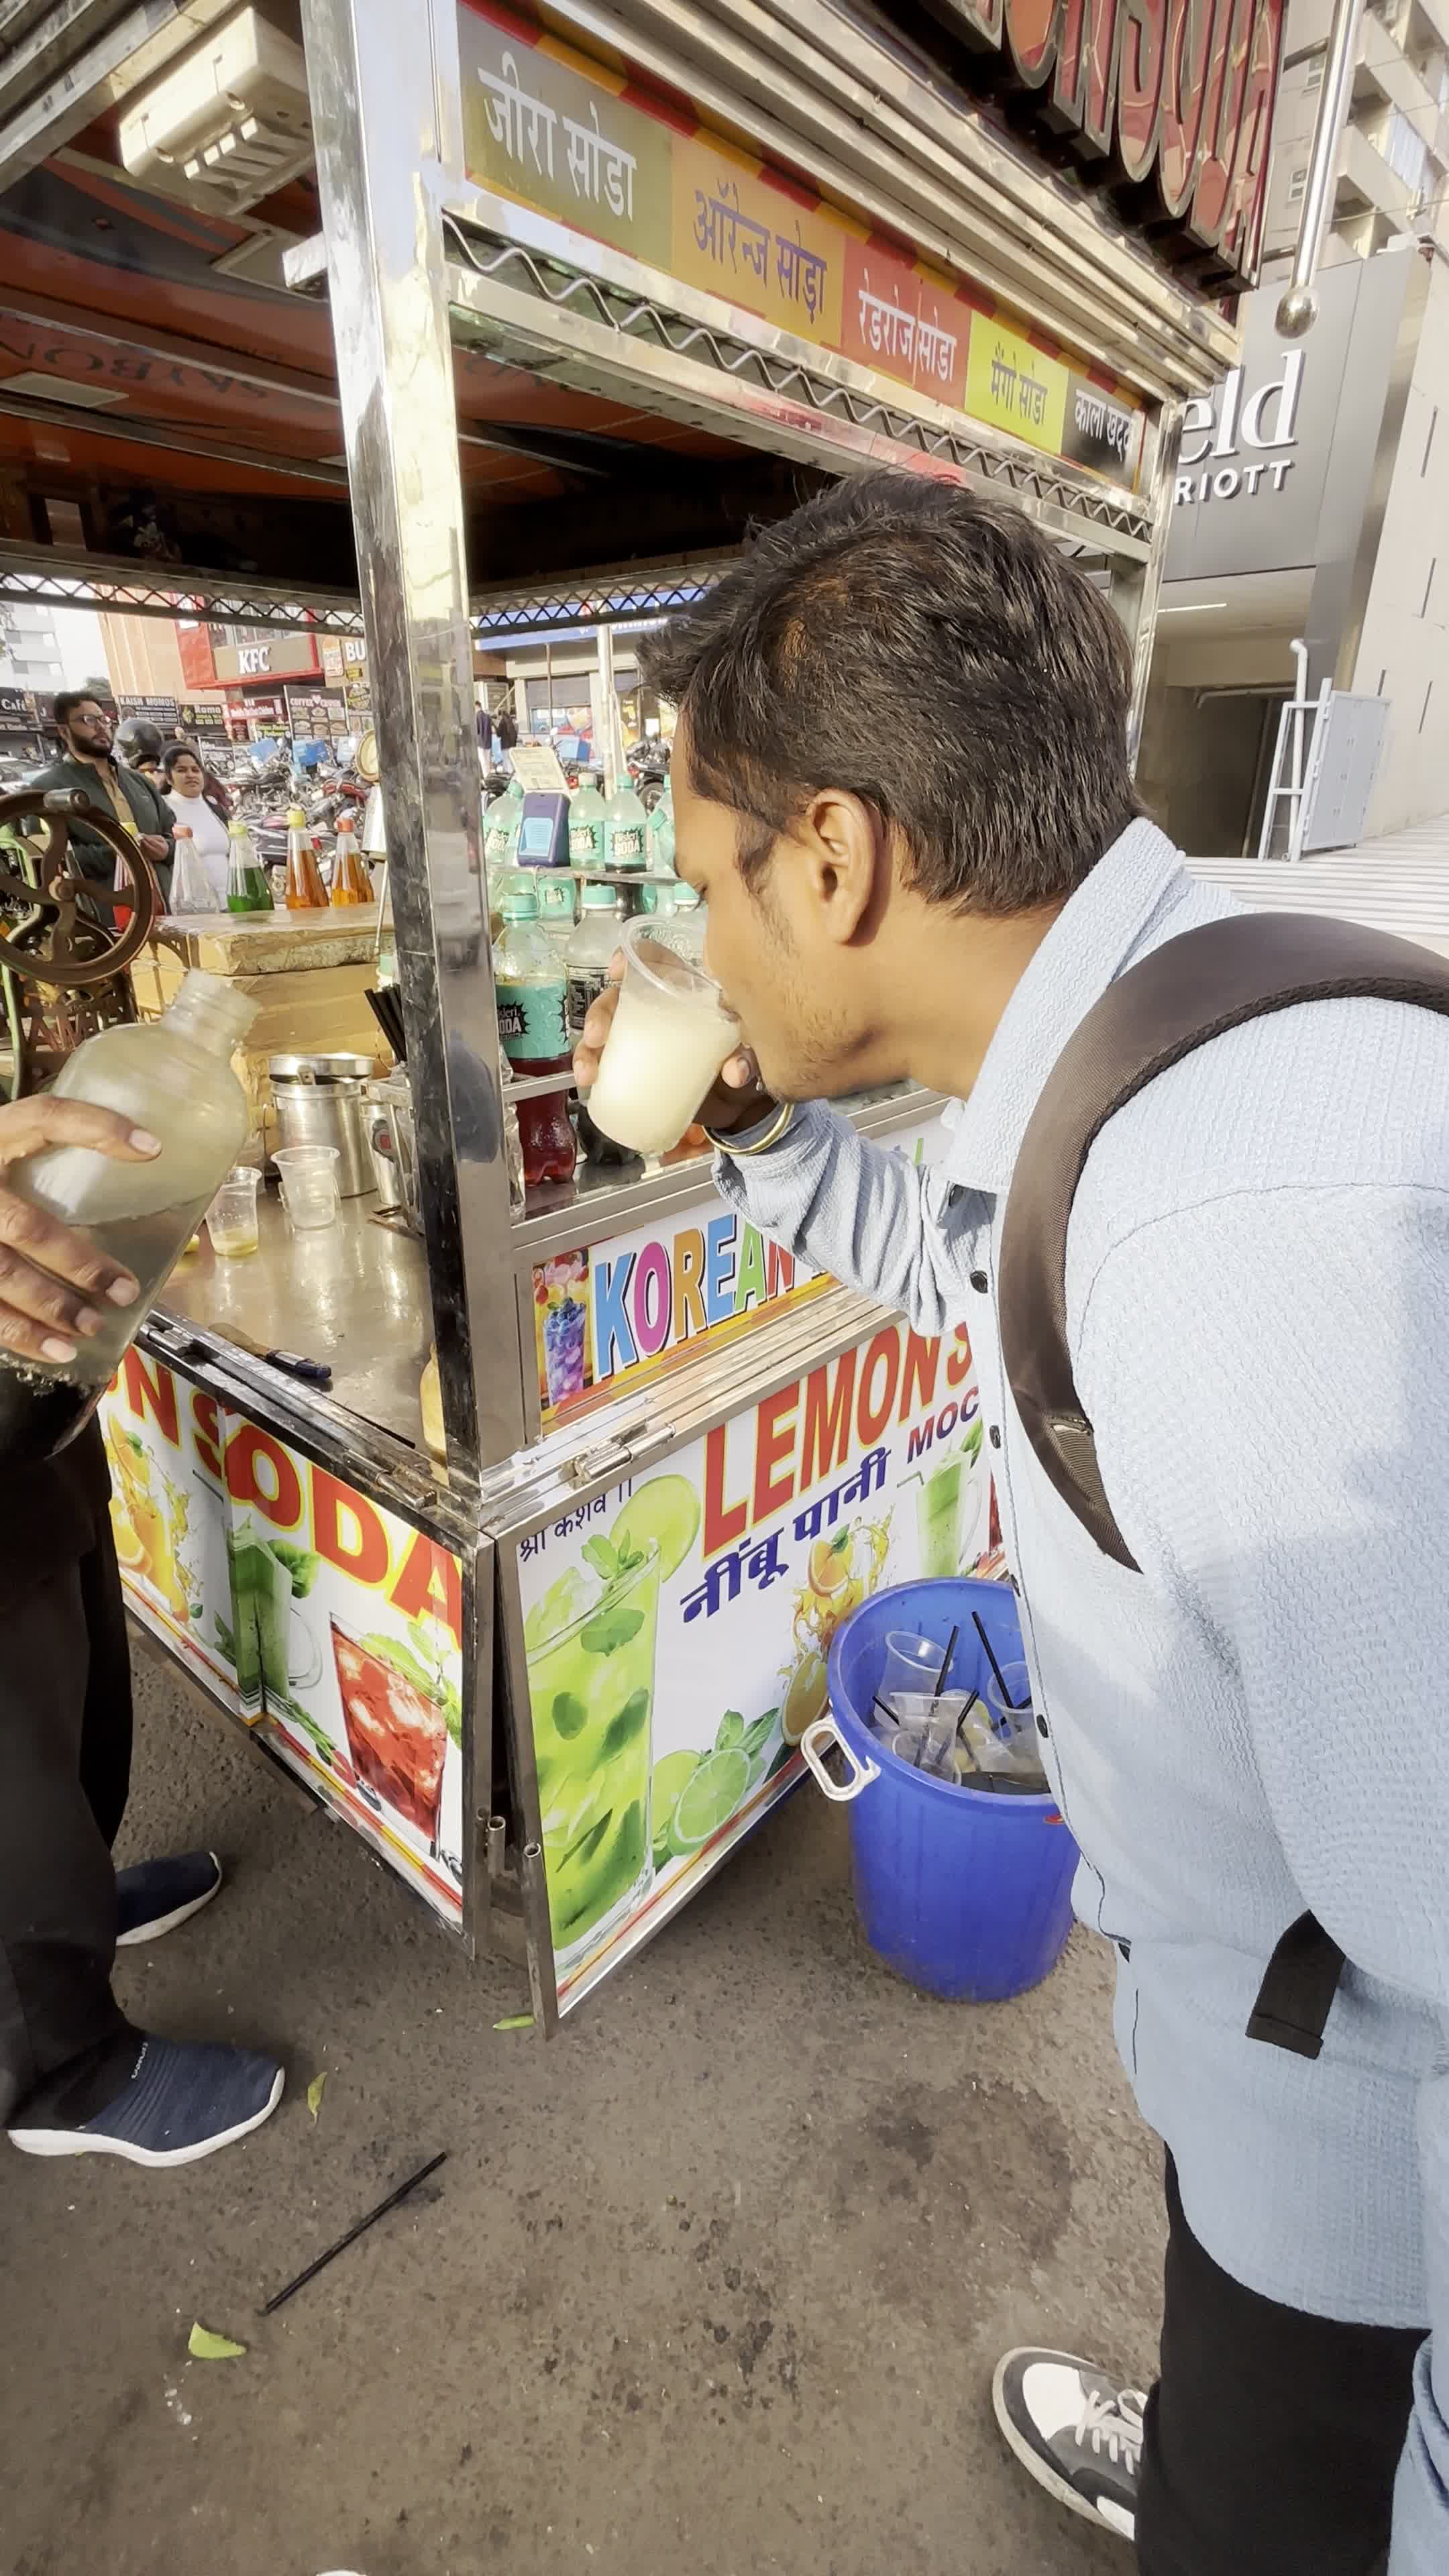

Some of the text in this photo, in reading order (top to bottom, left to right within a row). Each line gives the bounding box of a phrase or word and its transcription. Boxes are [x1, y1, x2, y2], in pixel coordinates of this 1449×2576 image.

[477, 51, 637, 222] जीरा सोडा
[1175, 459, 1293, 504] RIOTT
[238, 648, 271, 674] KFC
[499, 1013, 521, 1034] ODA
[593, 1213, 794, 1379] KOREAN
[907, 1384, 979, 1465] MOC
[792, 1446, 892, 1542] पानी
